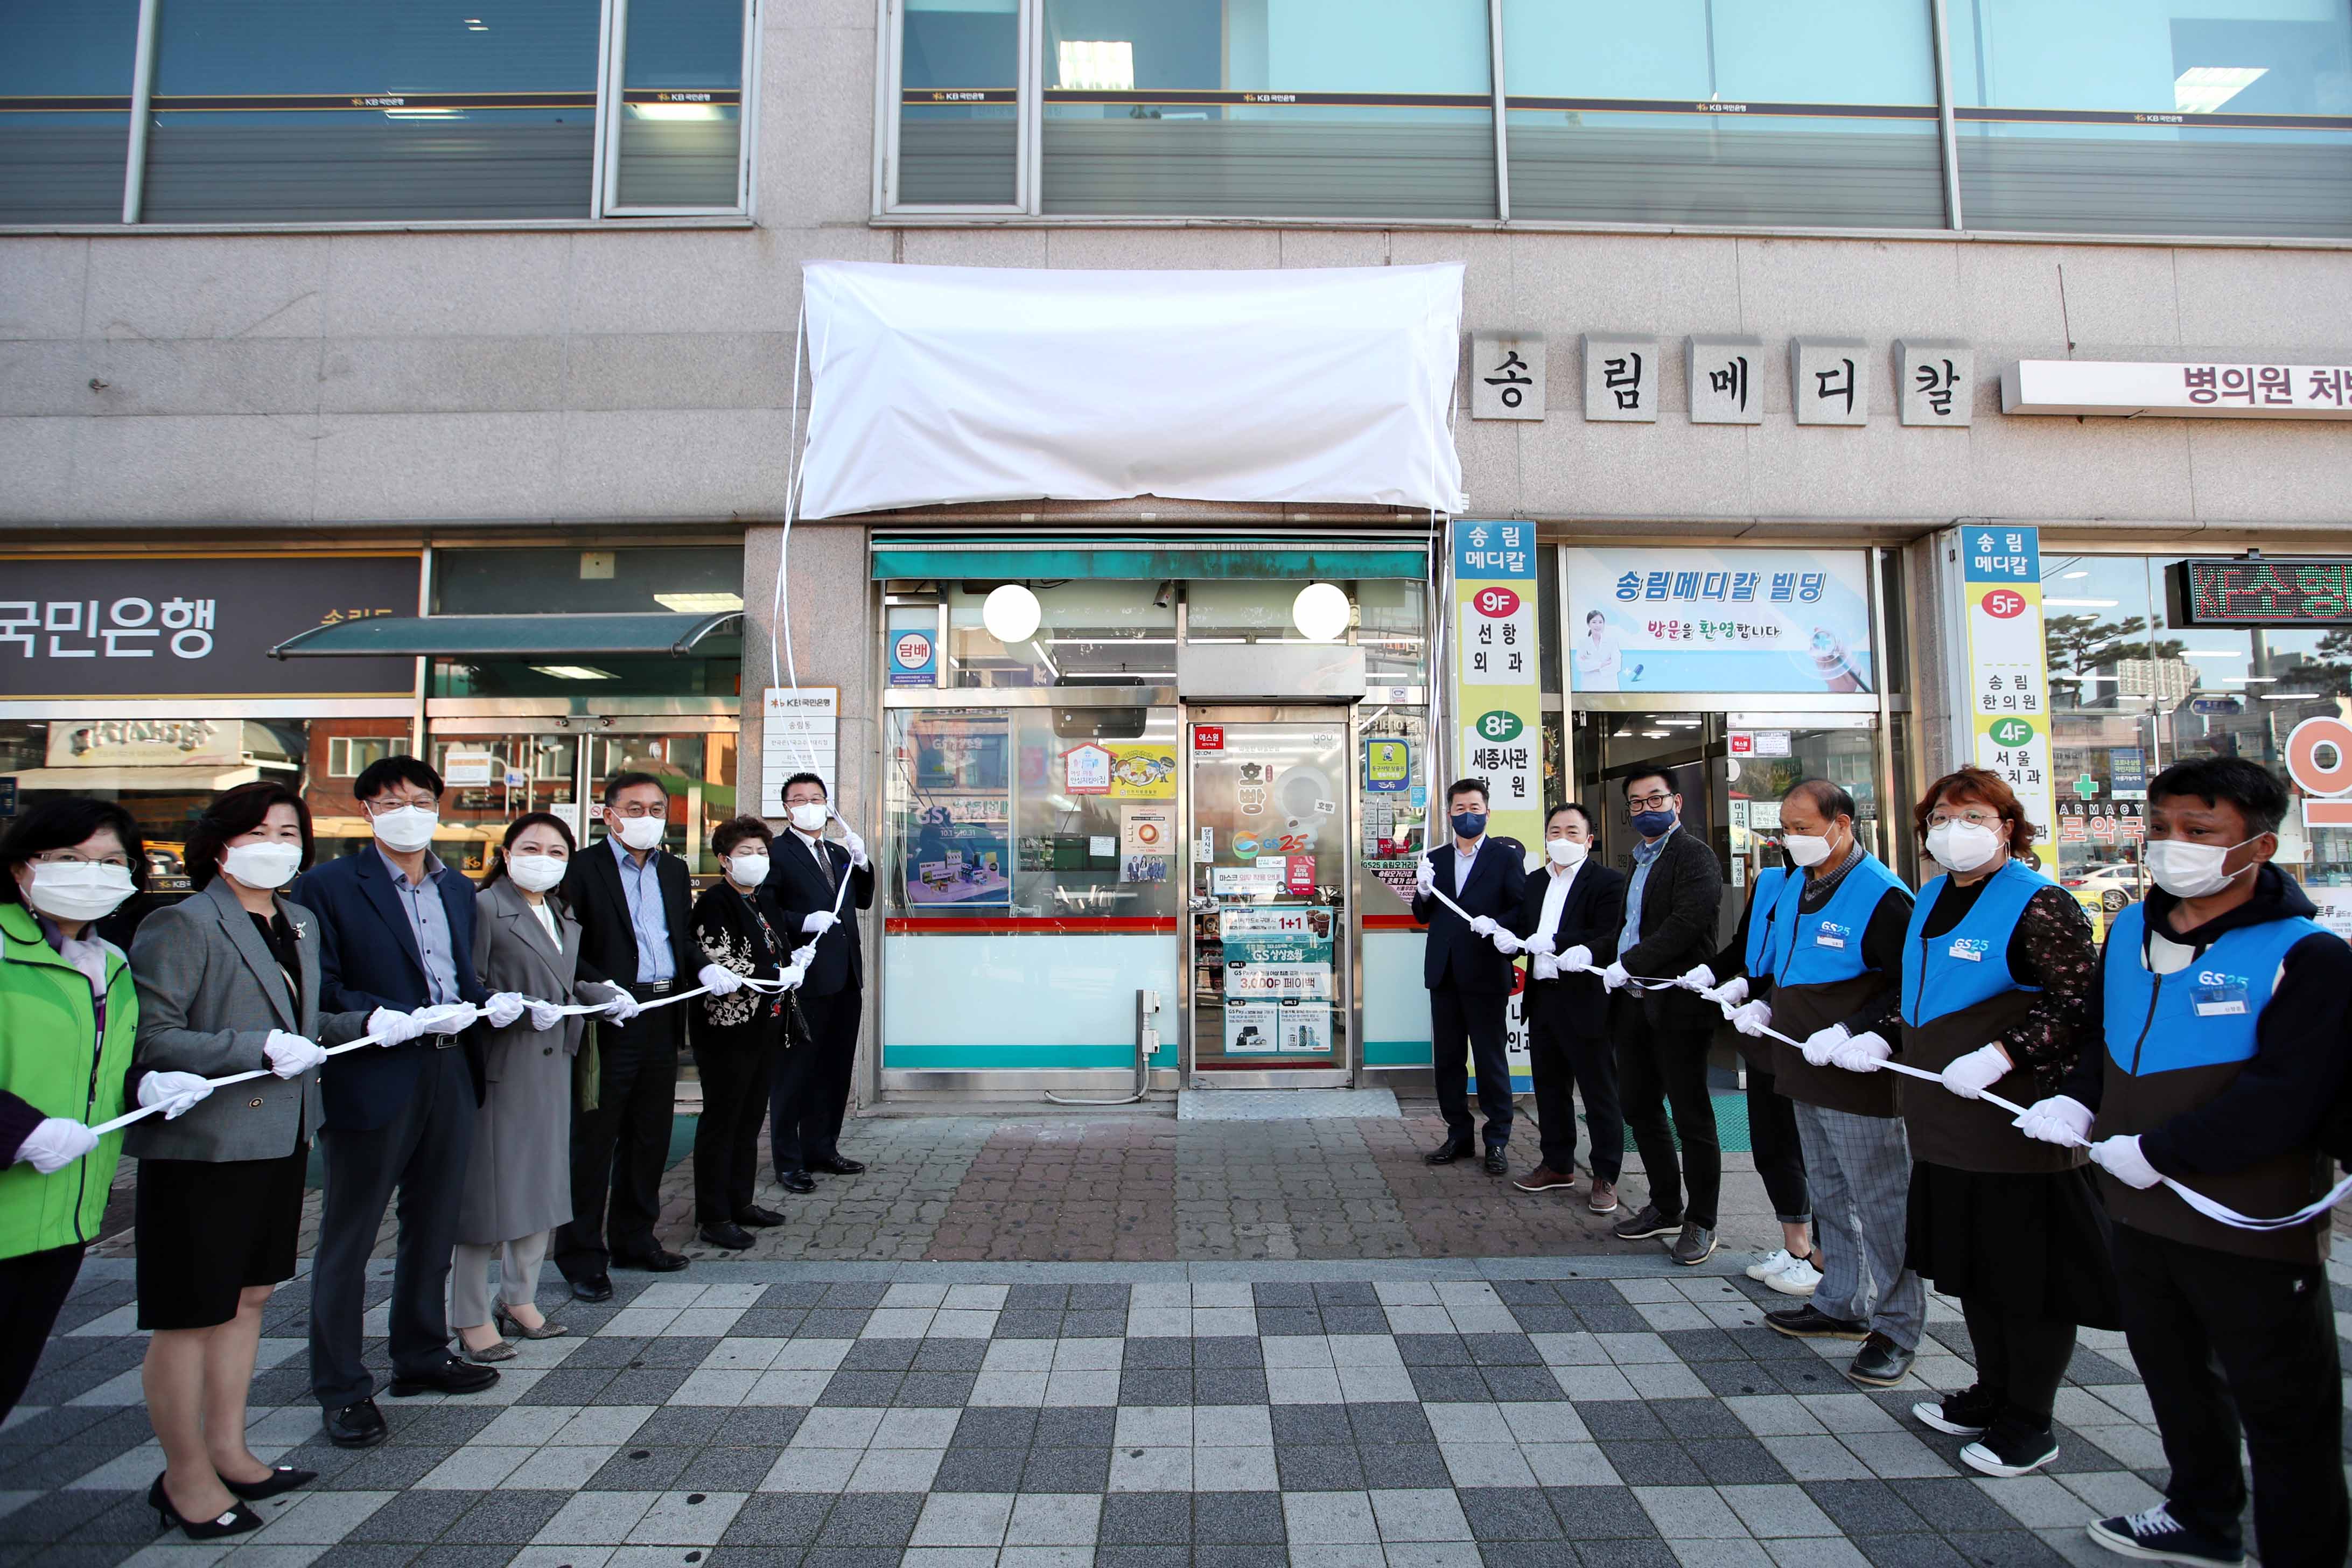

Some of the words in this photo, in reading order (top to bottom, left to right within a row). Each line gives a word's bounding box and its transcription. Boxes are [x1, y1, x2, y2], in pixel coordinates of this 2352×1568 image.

[2183, 366, 2294, 405] 병의원
[1465, 551, 1525, 572] 메디칼
[1975, 555, 2028, 575] 메디칼
[1615, 571, 1760, 602] 송림메디칼
[1769, 572, 1827, 603] 빌딩
[1482, 592, 1510, 612] 9F
[1992, 595, 2019, 614] 5F
[0, 597, 215, 659] 국민은행
[1648, 619, 1693, 640] 방문을
[1698, 620, 1781, 641] 환영합니다
[899, 643, 927, 657] 담배
[1982, 695, 2038, 711] 한의원
[1485, 716, 1514, 736] 8F
[1999, 722, 2027, 741] 4F
[1199, 733, 1219, 741] 에스원
[1472, 748, 1528, 770] 세종사관
[1996, 752, 2030, 766] 서울
[2007, 769, 2042, 785] 치과
[1734, 802, 1745, 850] 미끄럼의
[2060, 816, 2146, 844] 로약국
[1263, 834, 1308, 853] GS25
[1279, 918, 1301, 929] 1+1
[1822, 921, 1851, 936] GS25
[1955, 938, 1990, 951] GS25
[1284, 977, 1315, 988] 페이백
[2199, 970, 2249, 989] GS25
